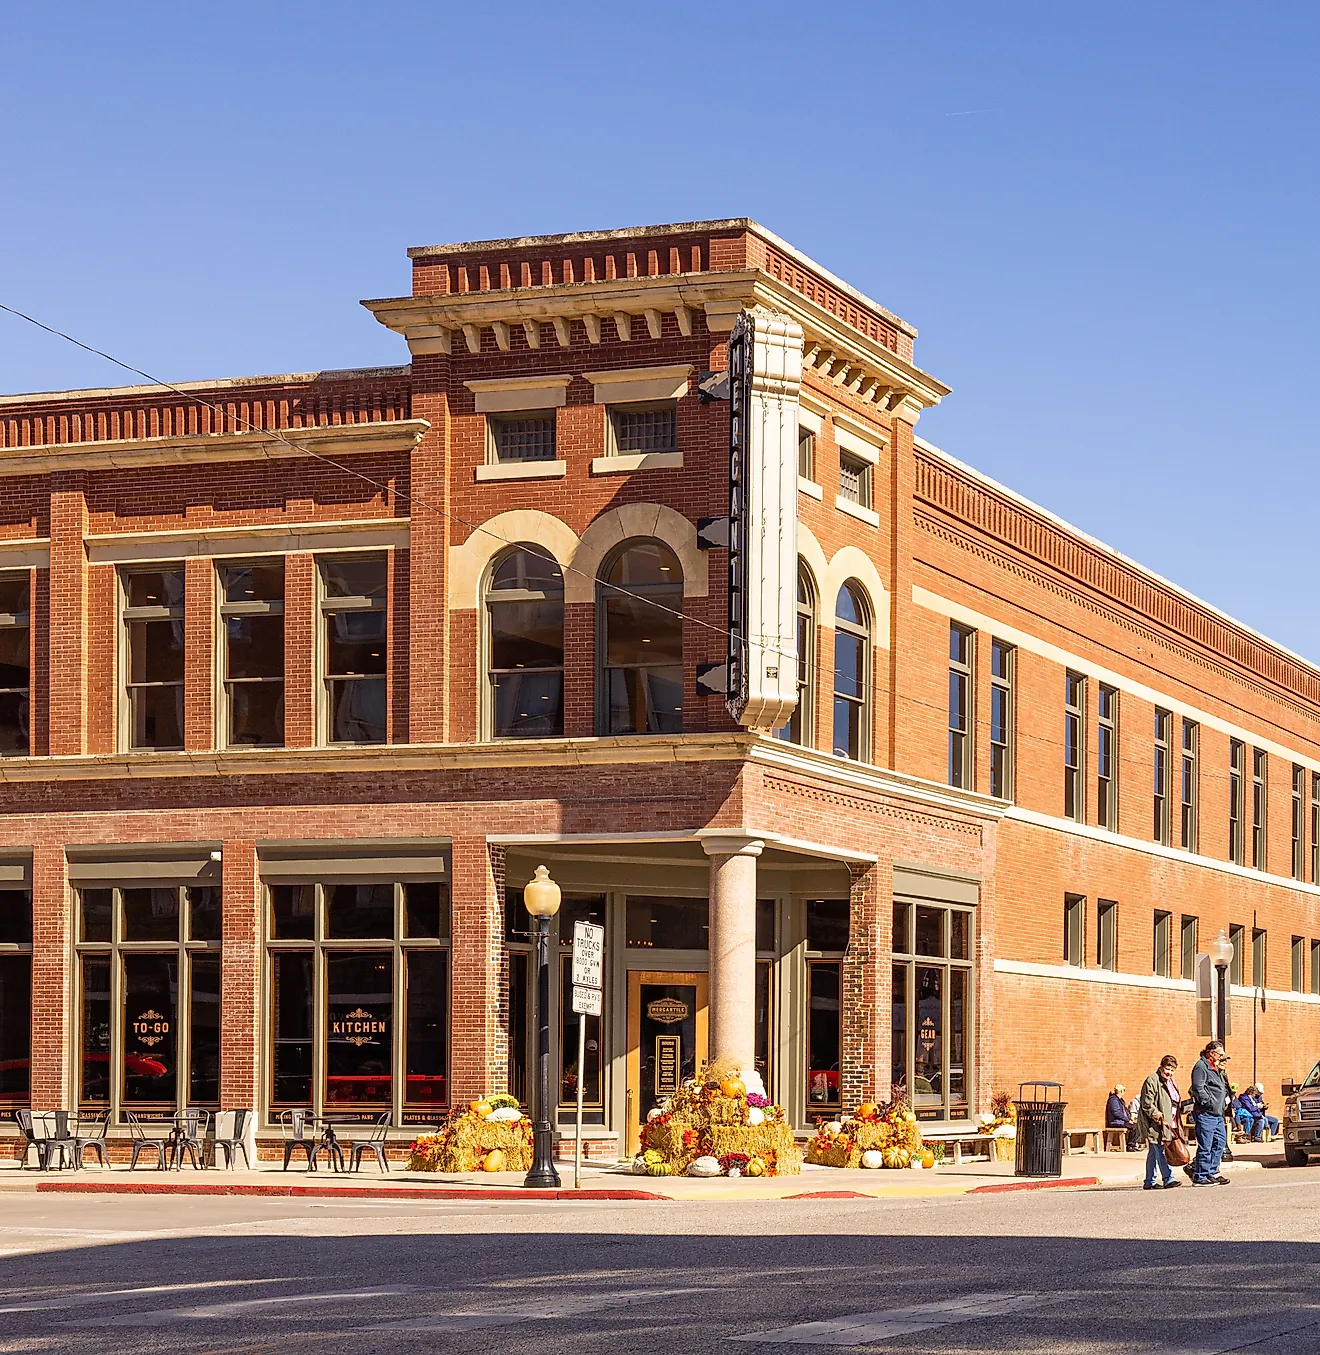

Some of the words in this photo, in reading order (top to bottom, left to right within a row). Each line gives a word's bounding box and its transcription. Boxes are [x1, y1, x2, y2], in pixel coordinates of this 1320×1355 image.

[730, 343, 744, 692] MERCANTILE
[584, 927, 594, 939] NO
[577, 938, 600, 952] TRUCKS
[581, 950, 595, 959] OVER
[583, 967, 591, 975] OR
[582, 975, 598, 985] AXLES
[132, 1022, 169, 1033] TO-GO
[333, 1021, 386, 1033] KITCHEN
[920, 1029, 936, 1040] GEAR
